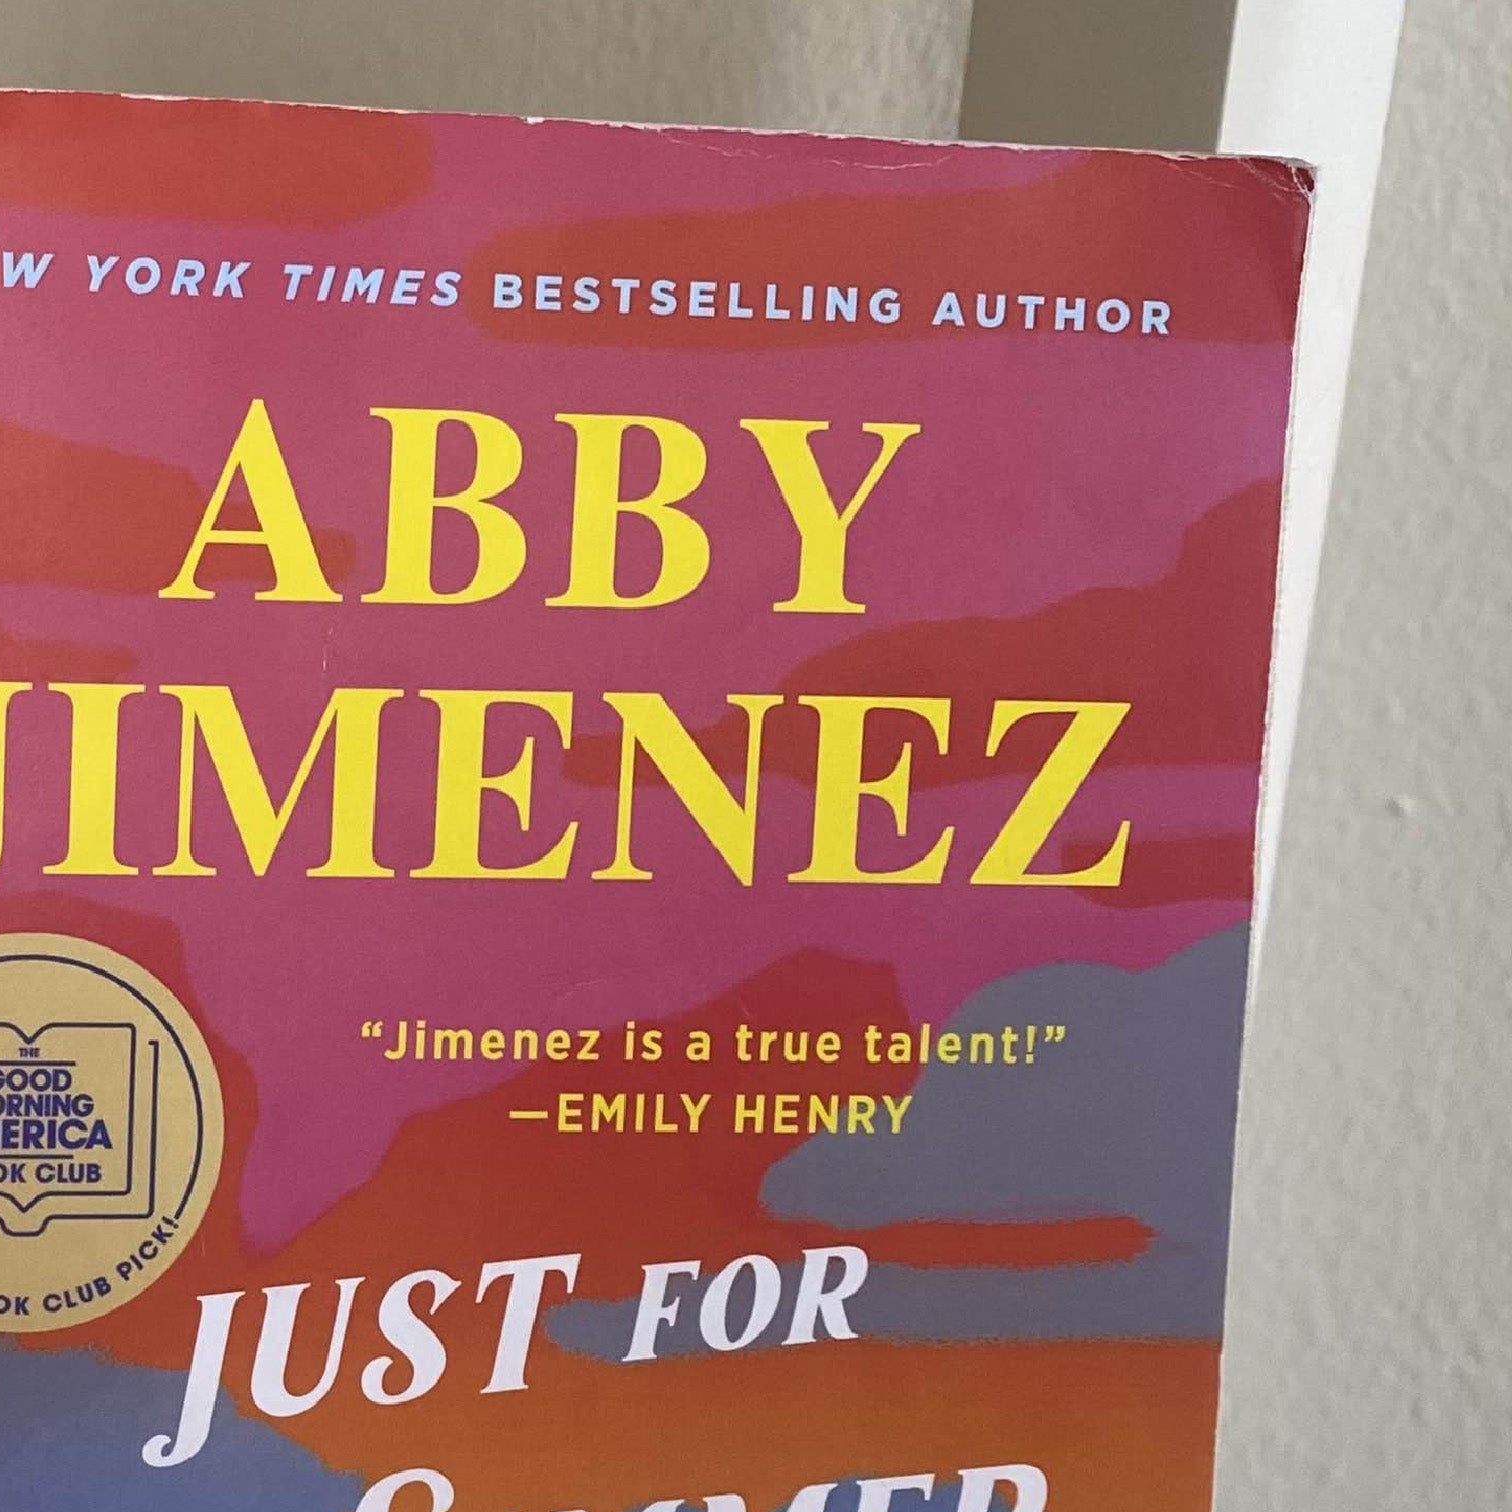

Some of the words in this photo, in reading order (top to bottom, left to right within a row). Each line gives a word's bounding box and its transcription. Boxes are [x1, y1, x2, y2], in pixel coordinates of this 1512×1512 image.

[86, 255, 252, 299] YORK
[283, 263, 462, 308] TIMES
[492, 272, 903, 325] BESTSELLING
[931, 291, 1172, 336] AUTHOR
[157, 397, 922, 615] ABBY
[18, 1046, 41, 1058] THE
[361, 1020, 600, 1062] “Jimenez
[624, 1021, 664, 1062] is
[685, 1030, 713, 1062] a
[734, 1023, 842, 1064] true
[863, 1022, 1067, 1066] talent!”
[733, 1093, 913, 1136] HENRY
[34, 1163, 102, 1185] CLUB
[42, 1276, 112, 1313] CLUB
[115, 1215, 181, 1282] PICK!
[141, 1253, 582, 1468] JUST
[621, 1245, 869, 1363] FOR
